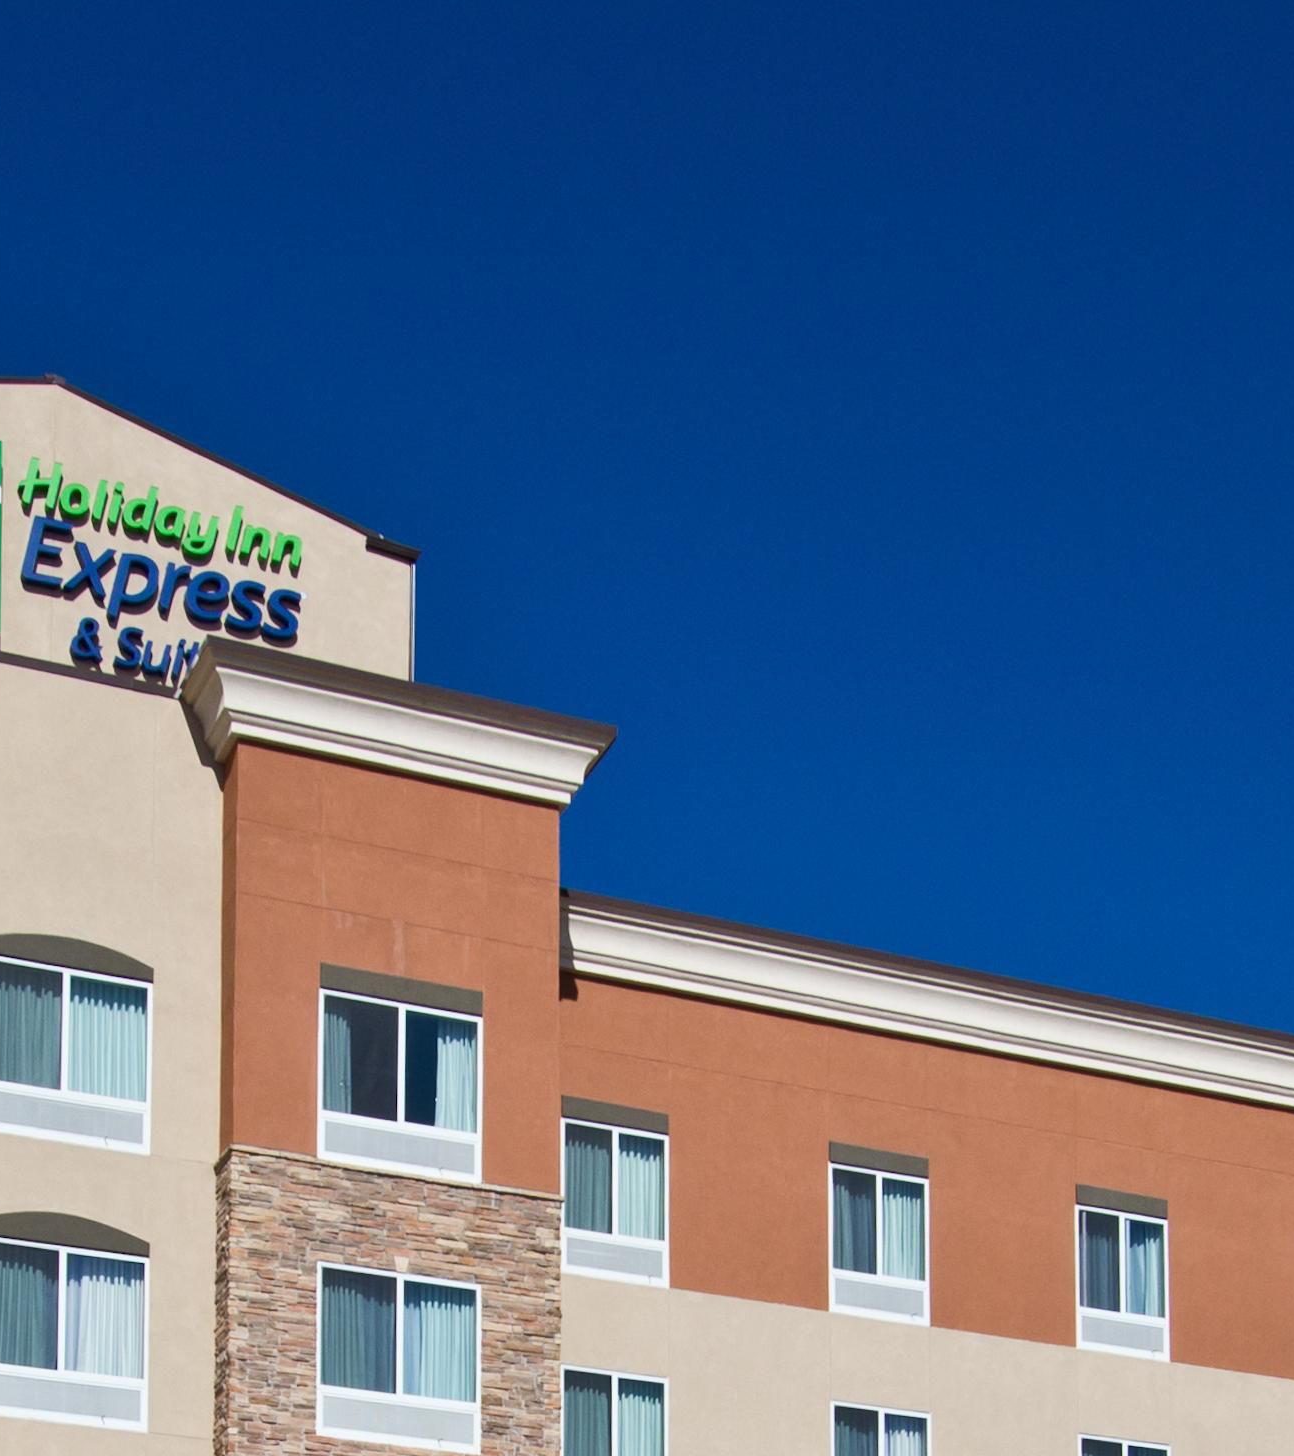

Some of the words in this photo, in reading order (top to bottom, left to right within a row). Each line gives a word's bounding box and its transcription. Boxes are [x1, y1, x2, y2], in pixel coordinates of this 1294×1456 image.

[16, 457, 219, 557] Holiday
[225, 505, 303, 570] Inn
[21, 515, 304, 638] Express
[69, 616, 103, 663] &
[113, 626, 201, 682] Suit
